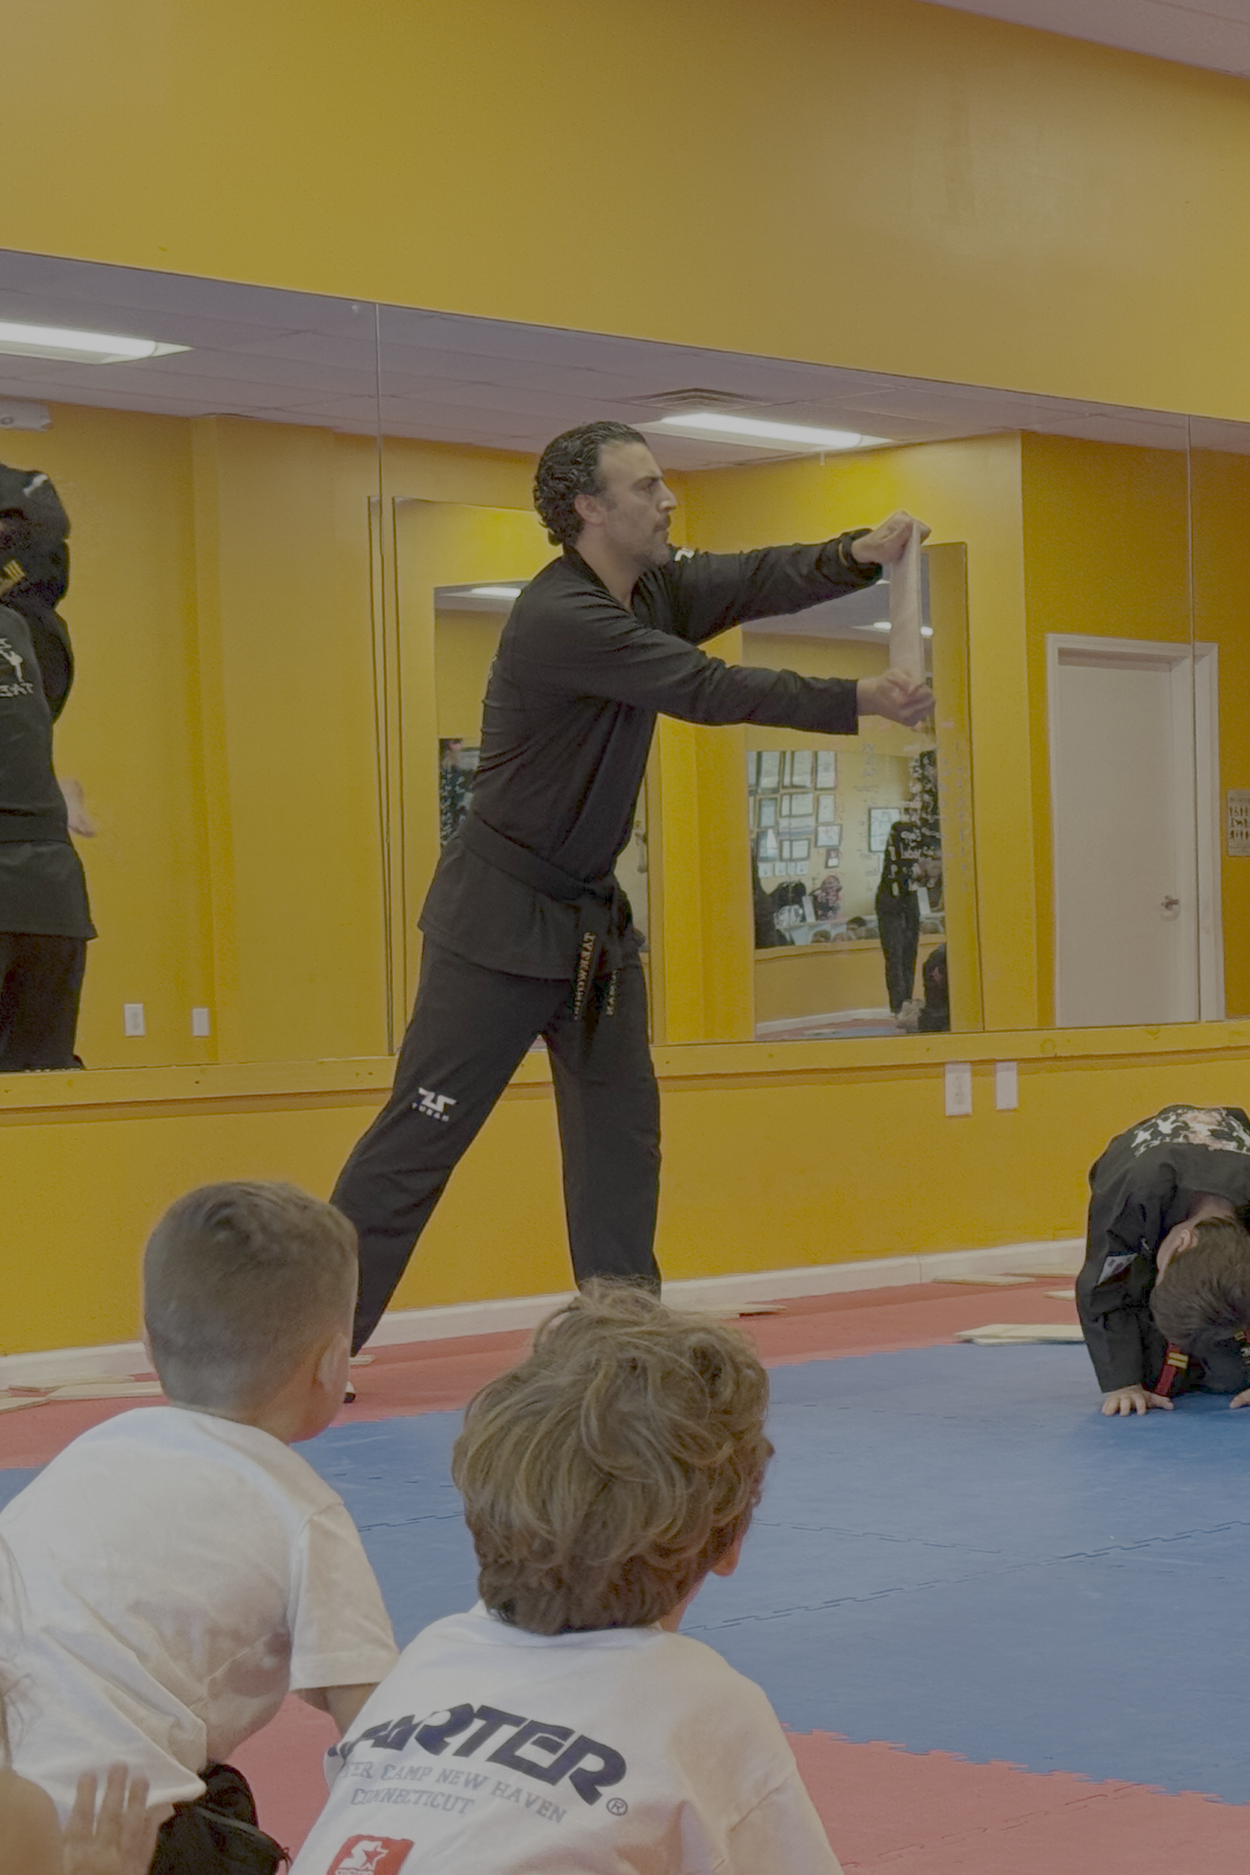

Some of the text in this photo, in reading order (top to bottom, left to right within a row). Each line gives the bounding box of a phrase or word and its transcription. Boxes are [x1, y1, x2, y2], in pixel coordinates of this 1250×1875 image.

[350, 1787, 475, 1815] CONNECTICUT
[380, 1764, 432, 1782] CAMP
[436, 1768, 489, 1791] NEW
[490, 1781, 568, 1824] HAVEN
